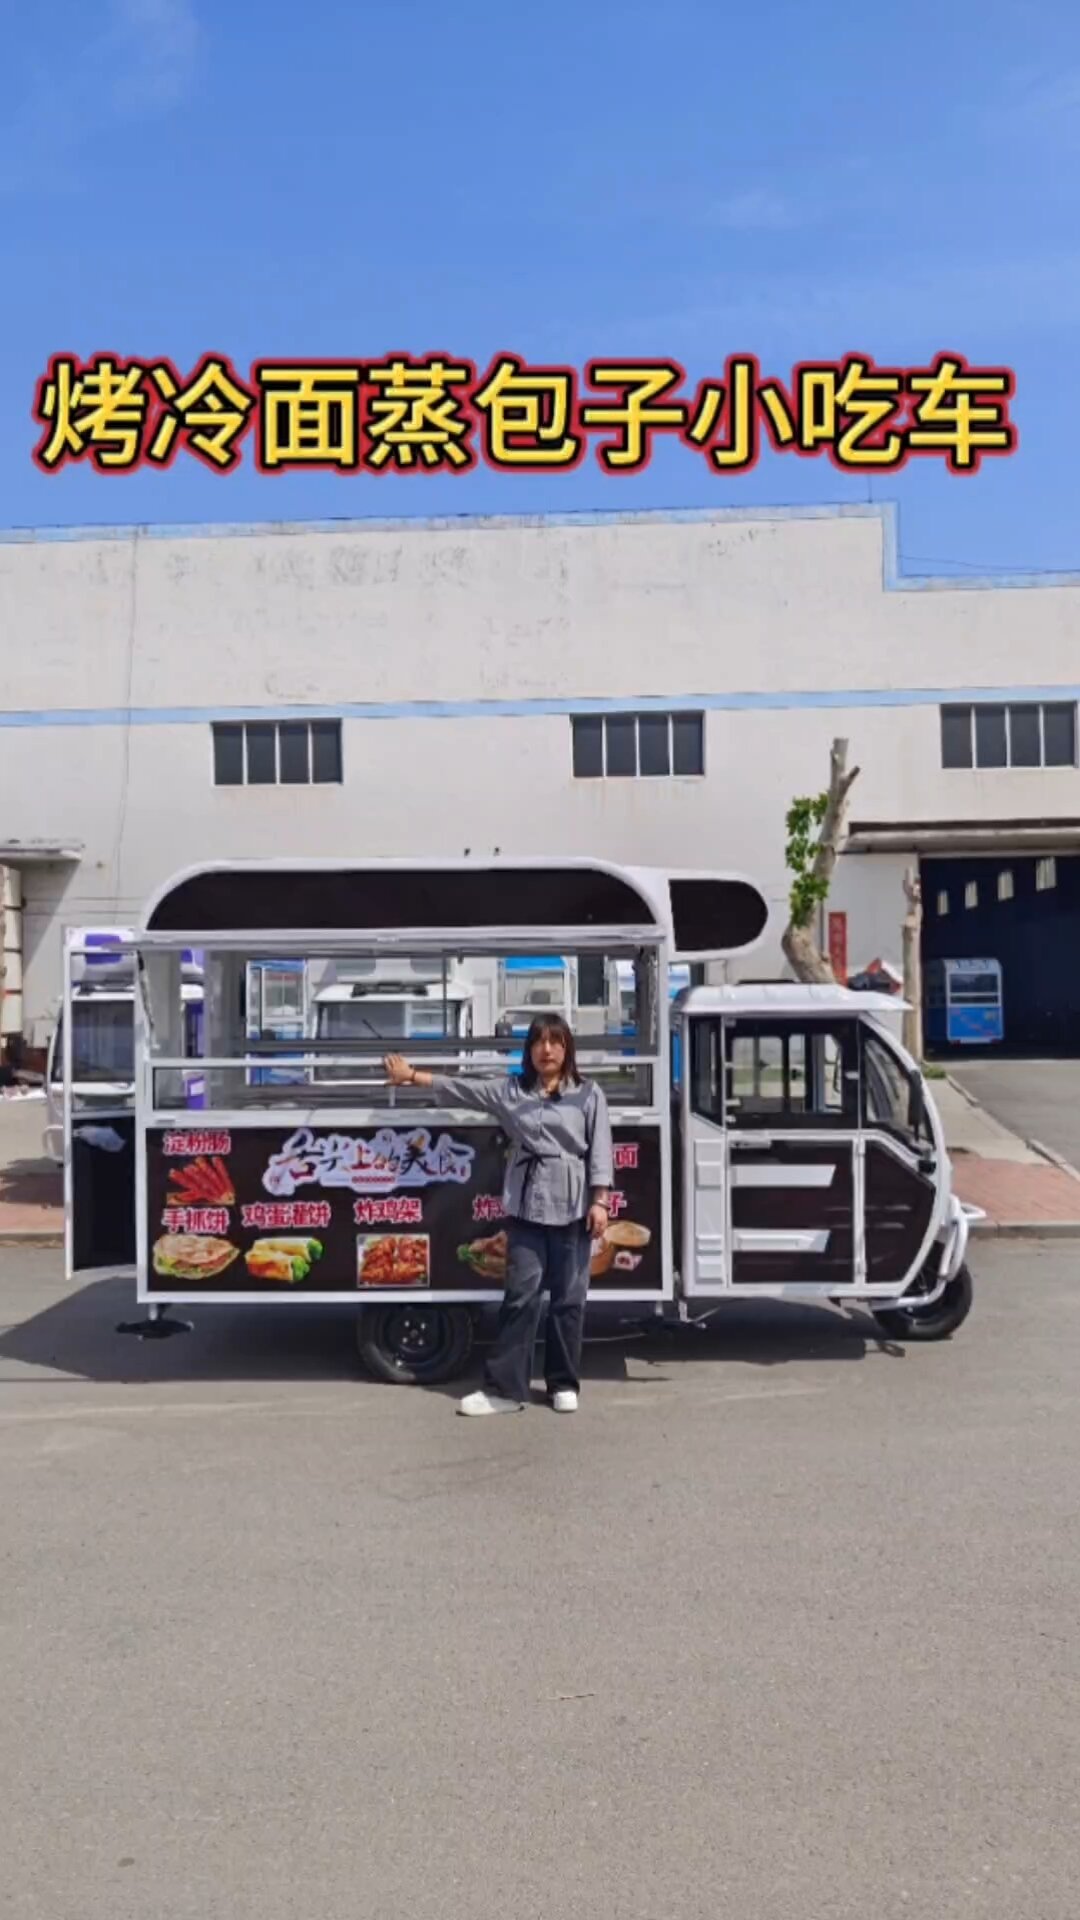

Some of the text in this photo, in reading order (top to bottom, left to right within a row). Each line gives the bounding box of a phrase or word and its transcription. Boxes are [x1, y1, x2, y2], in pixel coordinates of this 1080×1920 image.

[162, 1208, 229, 1233] 手抓饼
[242, 1202, 330, 1228] 鸡蛋灌饼
[354, 1199, 422, 1223] 炸鸡架
